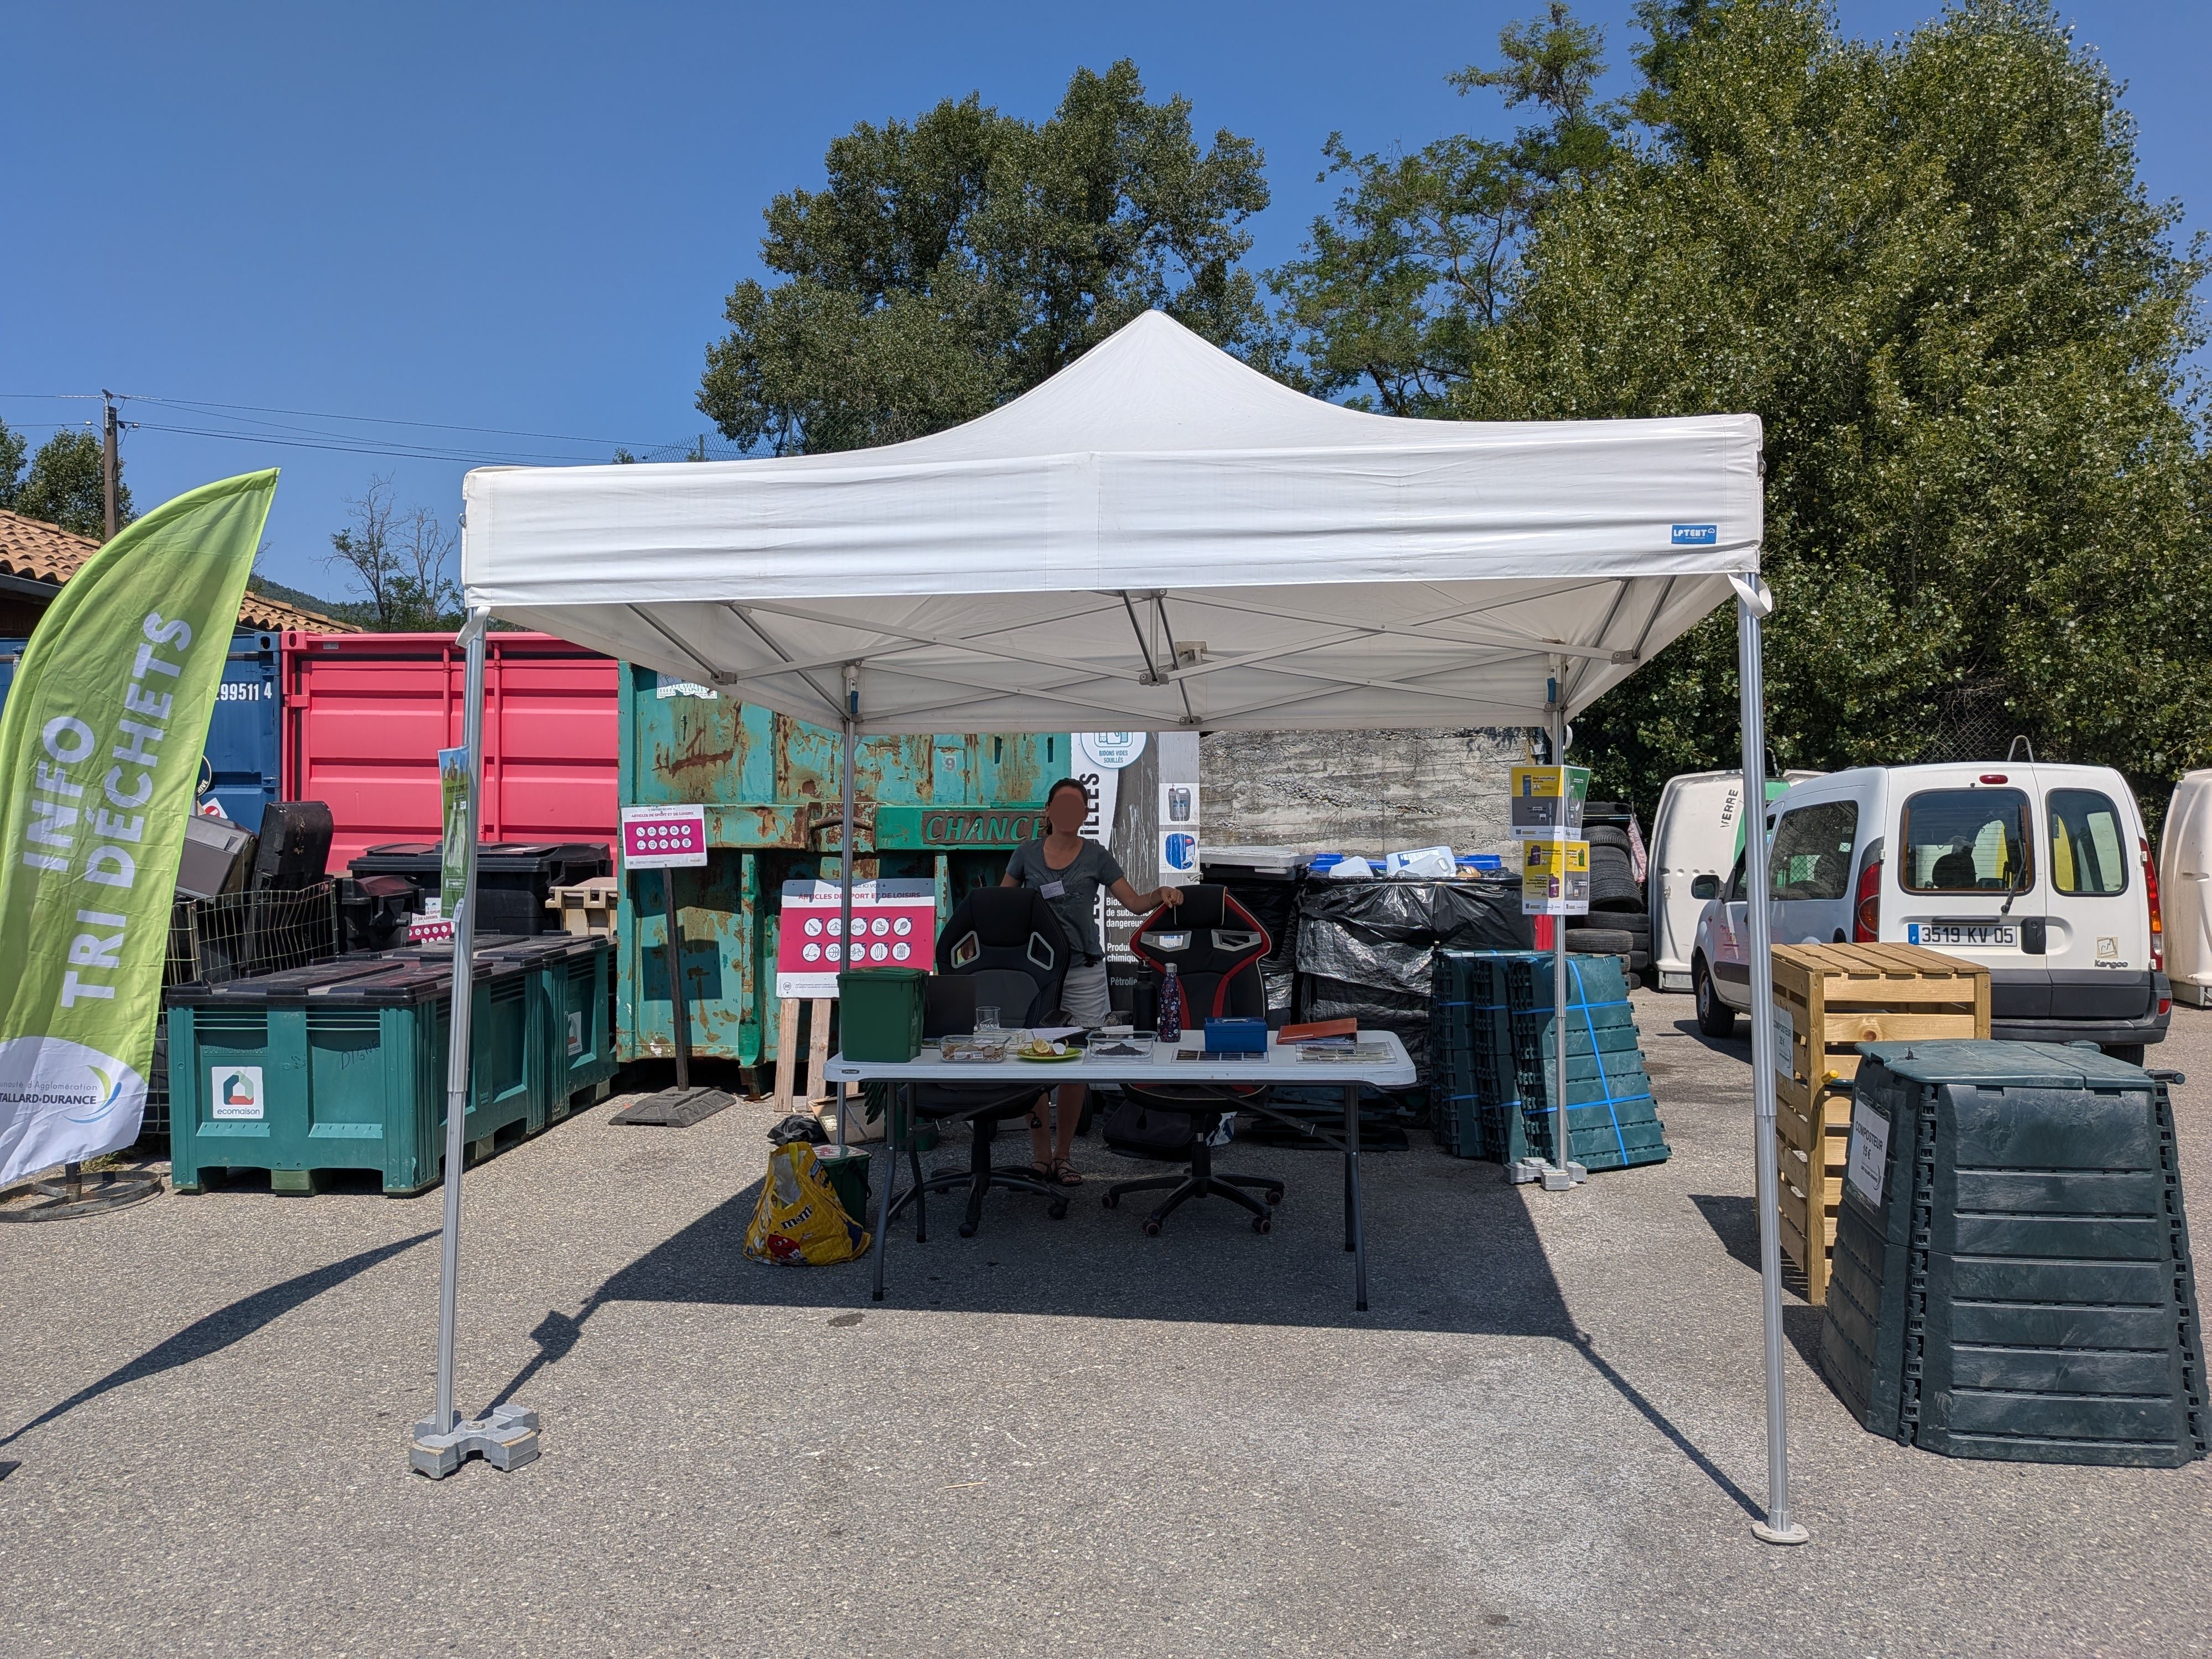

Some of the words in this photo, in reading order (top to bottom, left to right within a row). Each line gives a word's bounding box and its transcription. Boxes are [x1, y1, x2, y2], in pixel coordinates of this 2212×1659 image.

[84, 611, 192, 888] DÉCHETS
[23, 716, 95, 872] INFO
[1720, 789, 1739, 828] VERRE
[1106, 908, 1115, 917] de
[1922, 927, 1960, 943] 3519
[1968, 927, 1987, 943] KV
[1994, 928, 2013, 943] 05
[61, 909, 127, 1008] TRI
[2094, 959, 2128, 969] Kangoo
[217, 1107, 260, 1115] ecomaison
[1855, 1120, 1883, 1152] COMPOSTEUR
